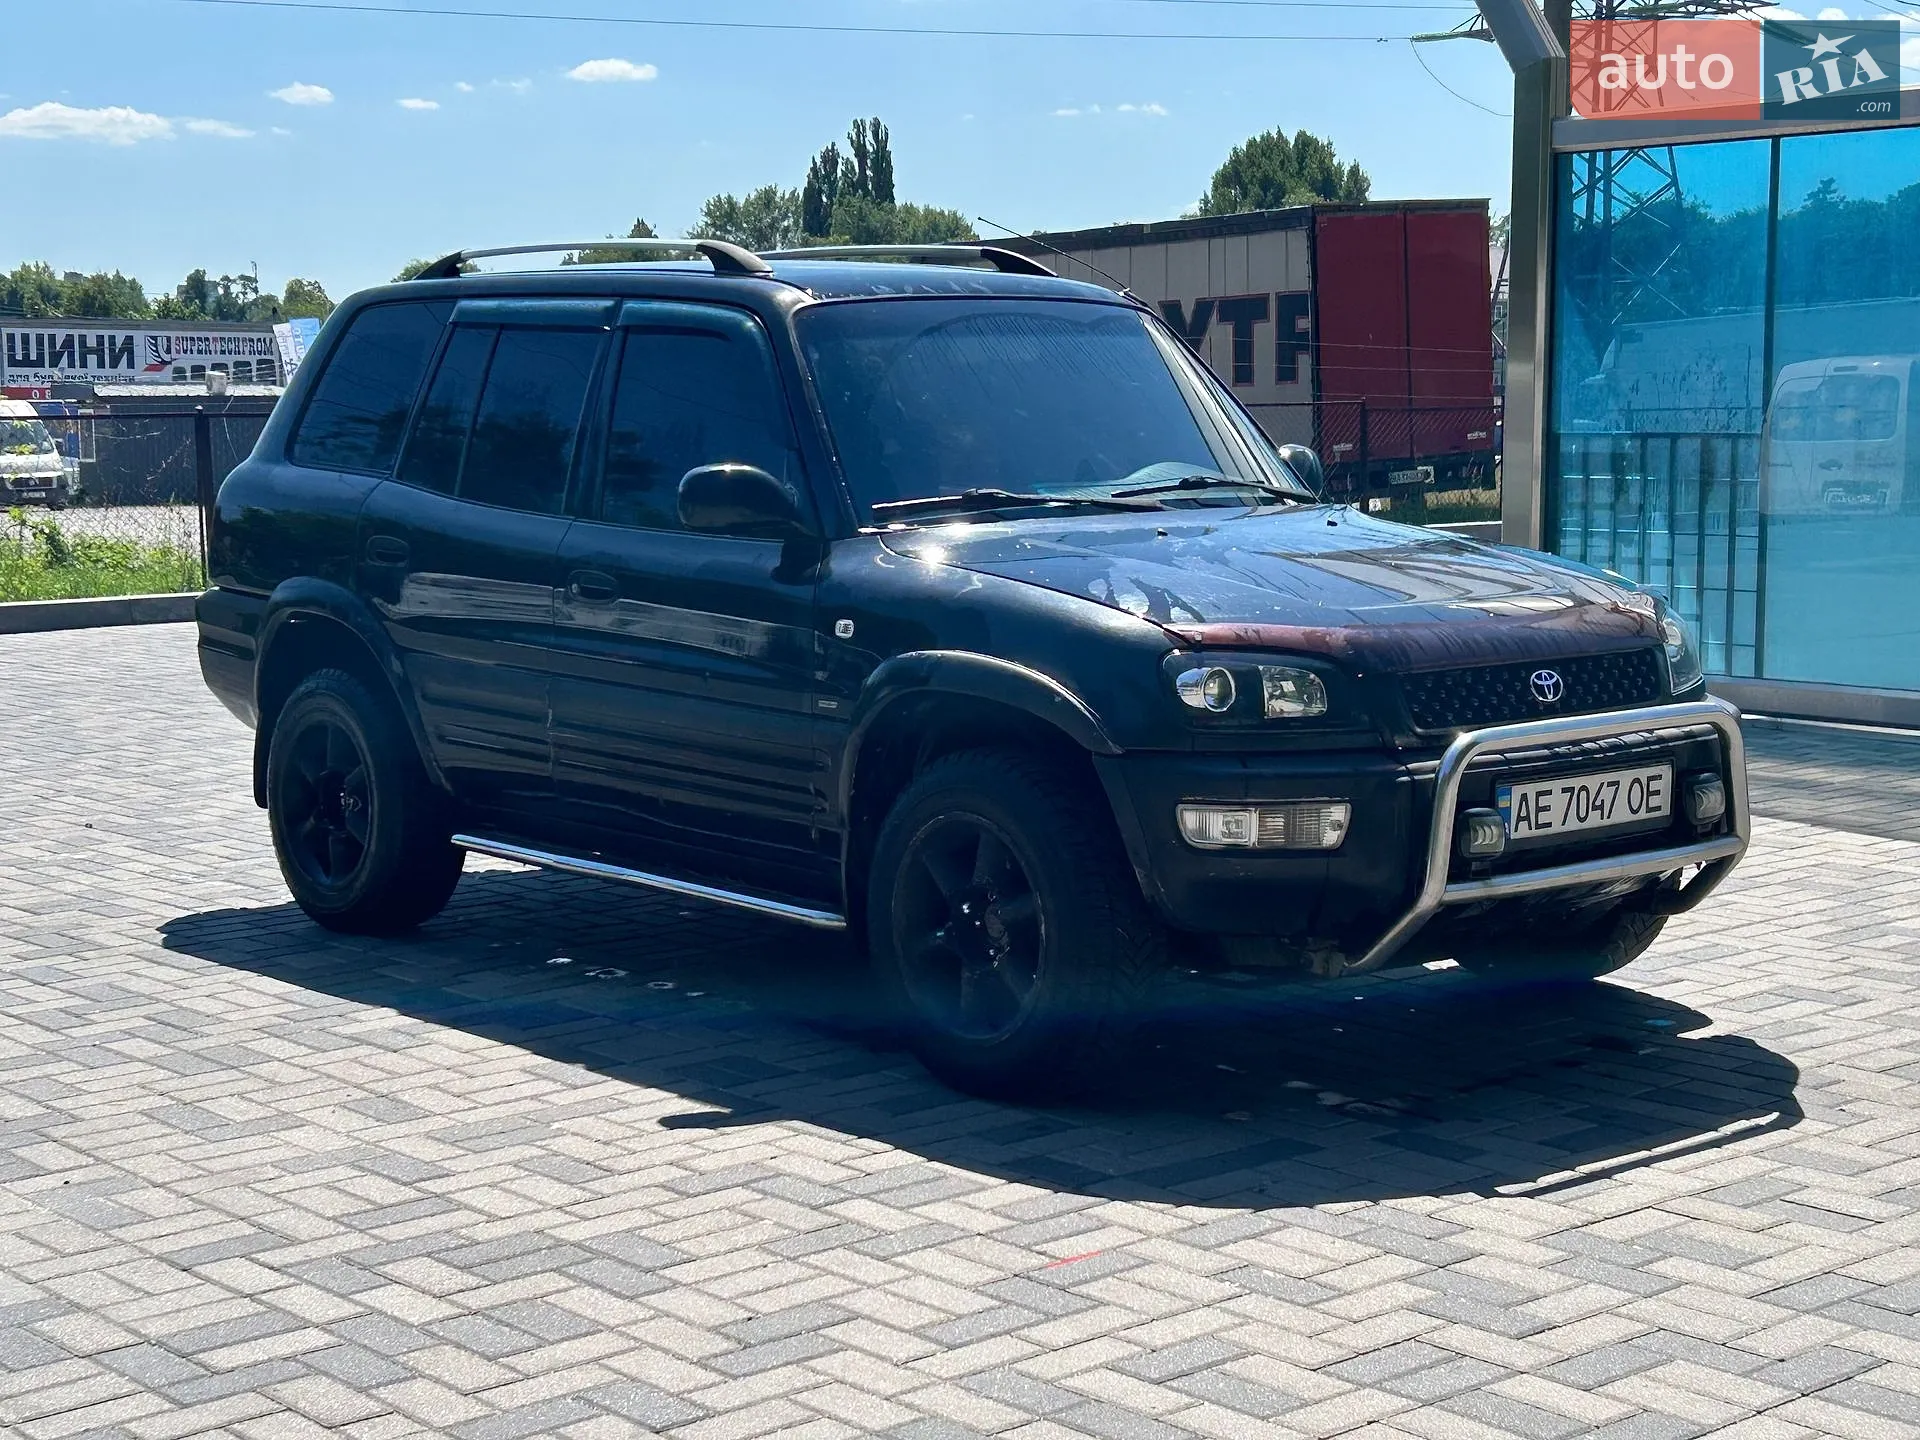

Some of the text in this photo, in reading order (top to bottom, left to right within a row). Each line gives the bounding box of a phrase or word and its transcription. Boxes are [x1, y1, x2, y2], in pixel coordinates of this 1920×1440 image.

[6, 332, 135, 369] ШИНИ
[174, 336, 273, 356] SUPERTECHPROM
[1514, 774, 1662, 833] AE 7047 OE
